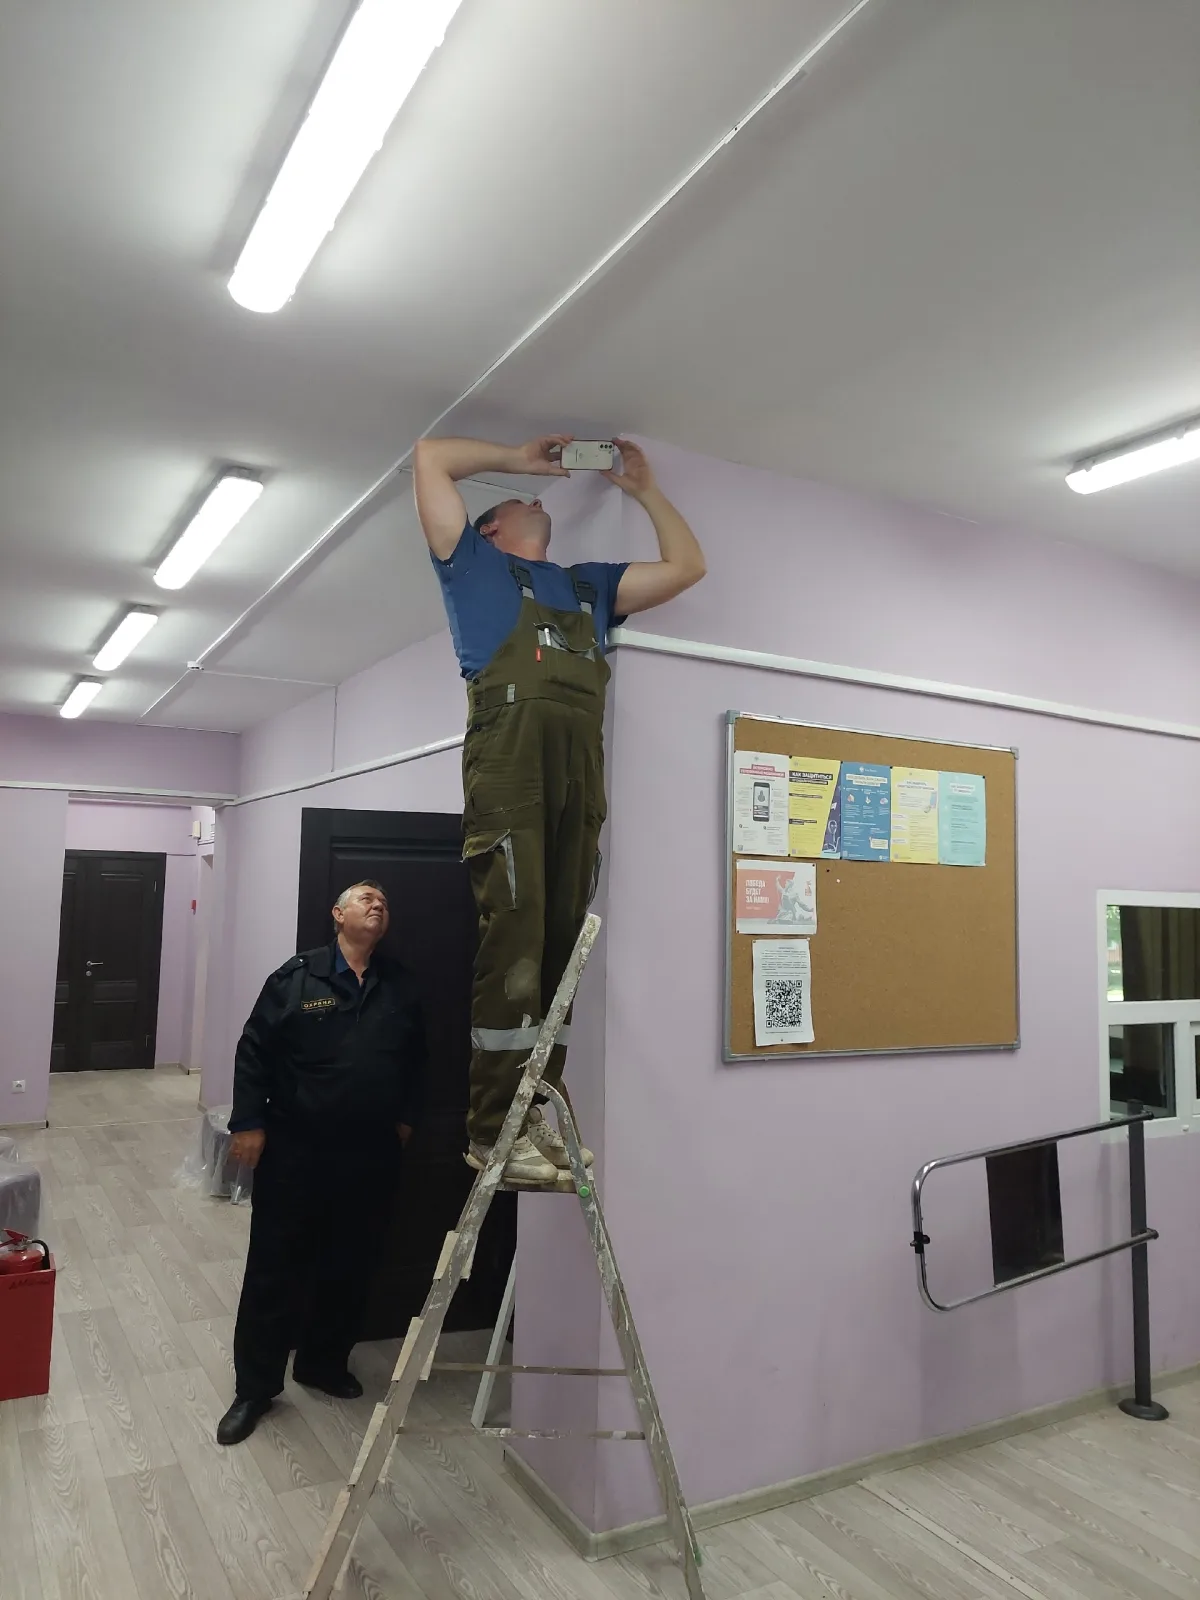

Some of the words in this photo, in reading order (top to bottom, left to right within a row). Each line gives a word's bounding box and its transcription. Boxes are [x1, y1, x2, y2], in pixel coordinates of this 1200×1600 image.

[746, 880, 765, 888] ПОБЕДА
[746, 888, 761, 896] БУДЕТ
[303, 1000, 332, 1008] ОХРАНА
